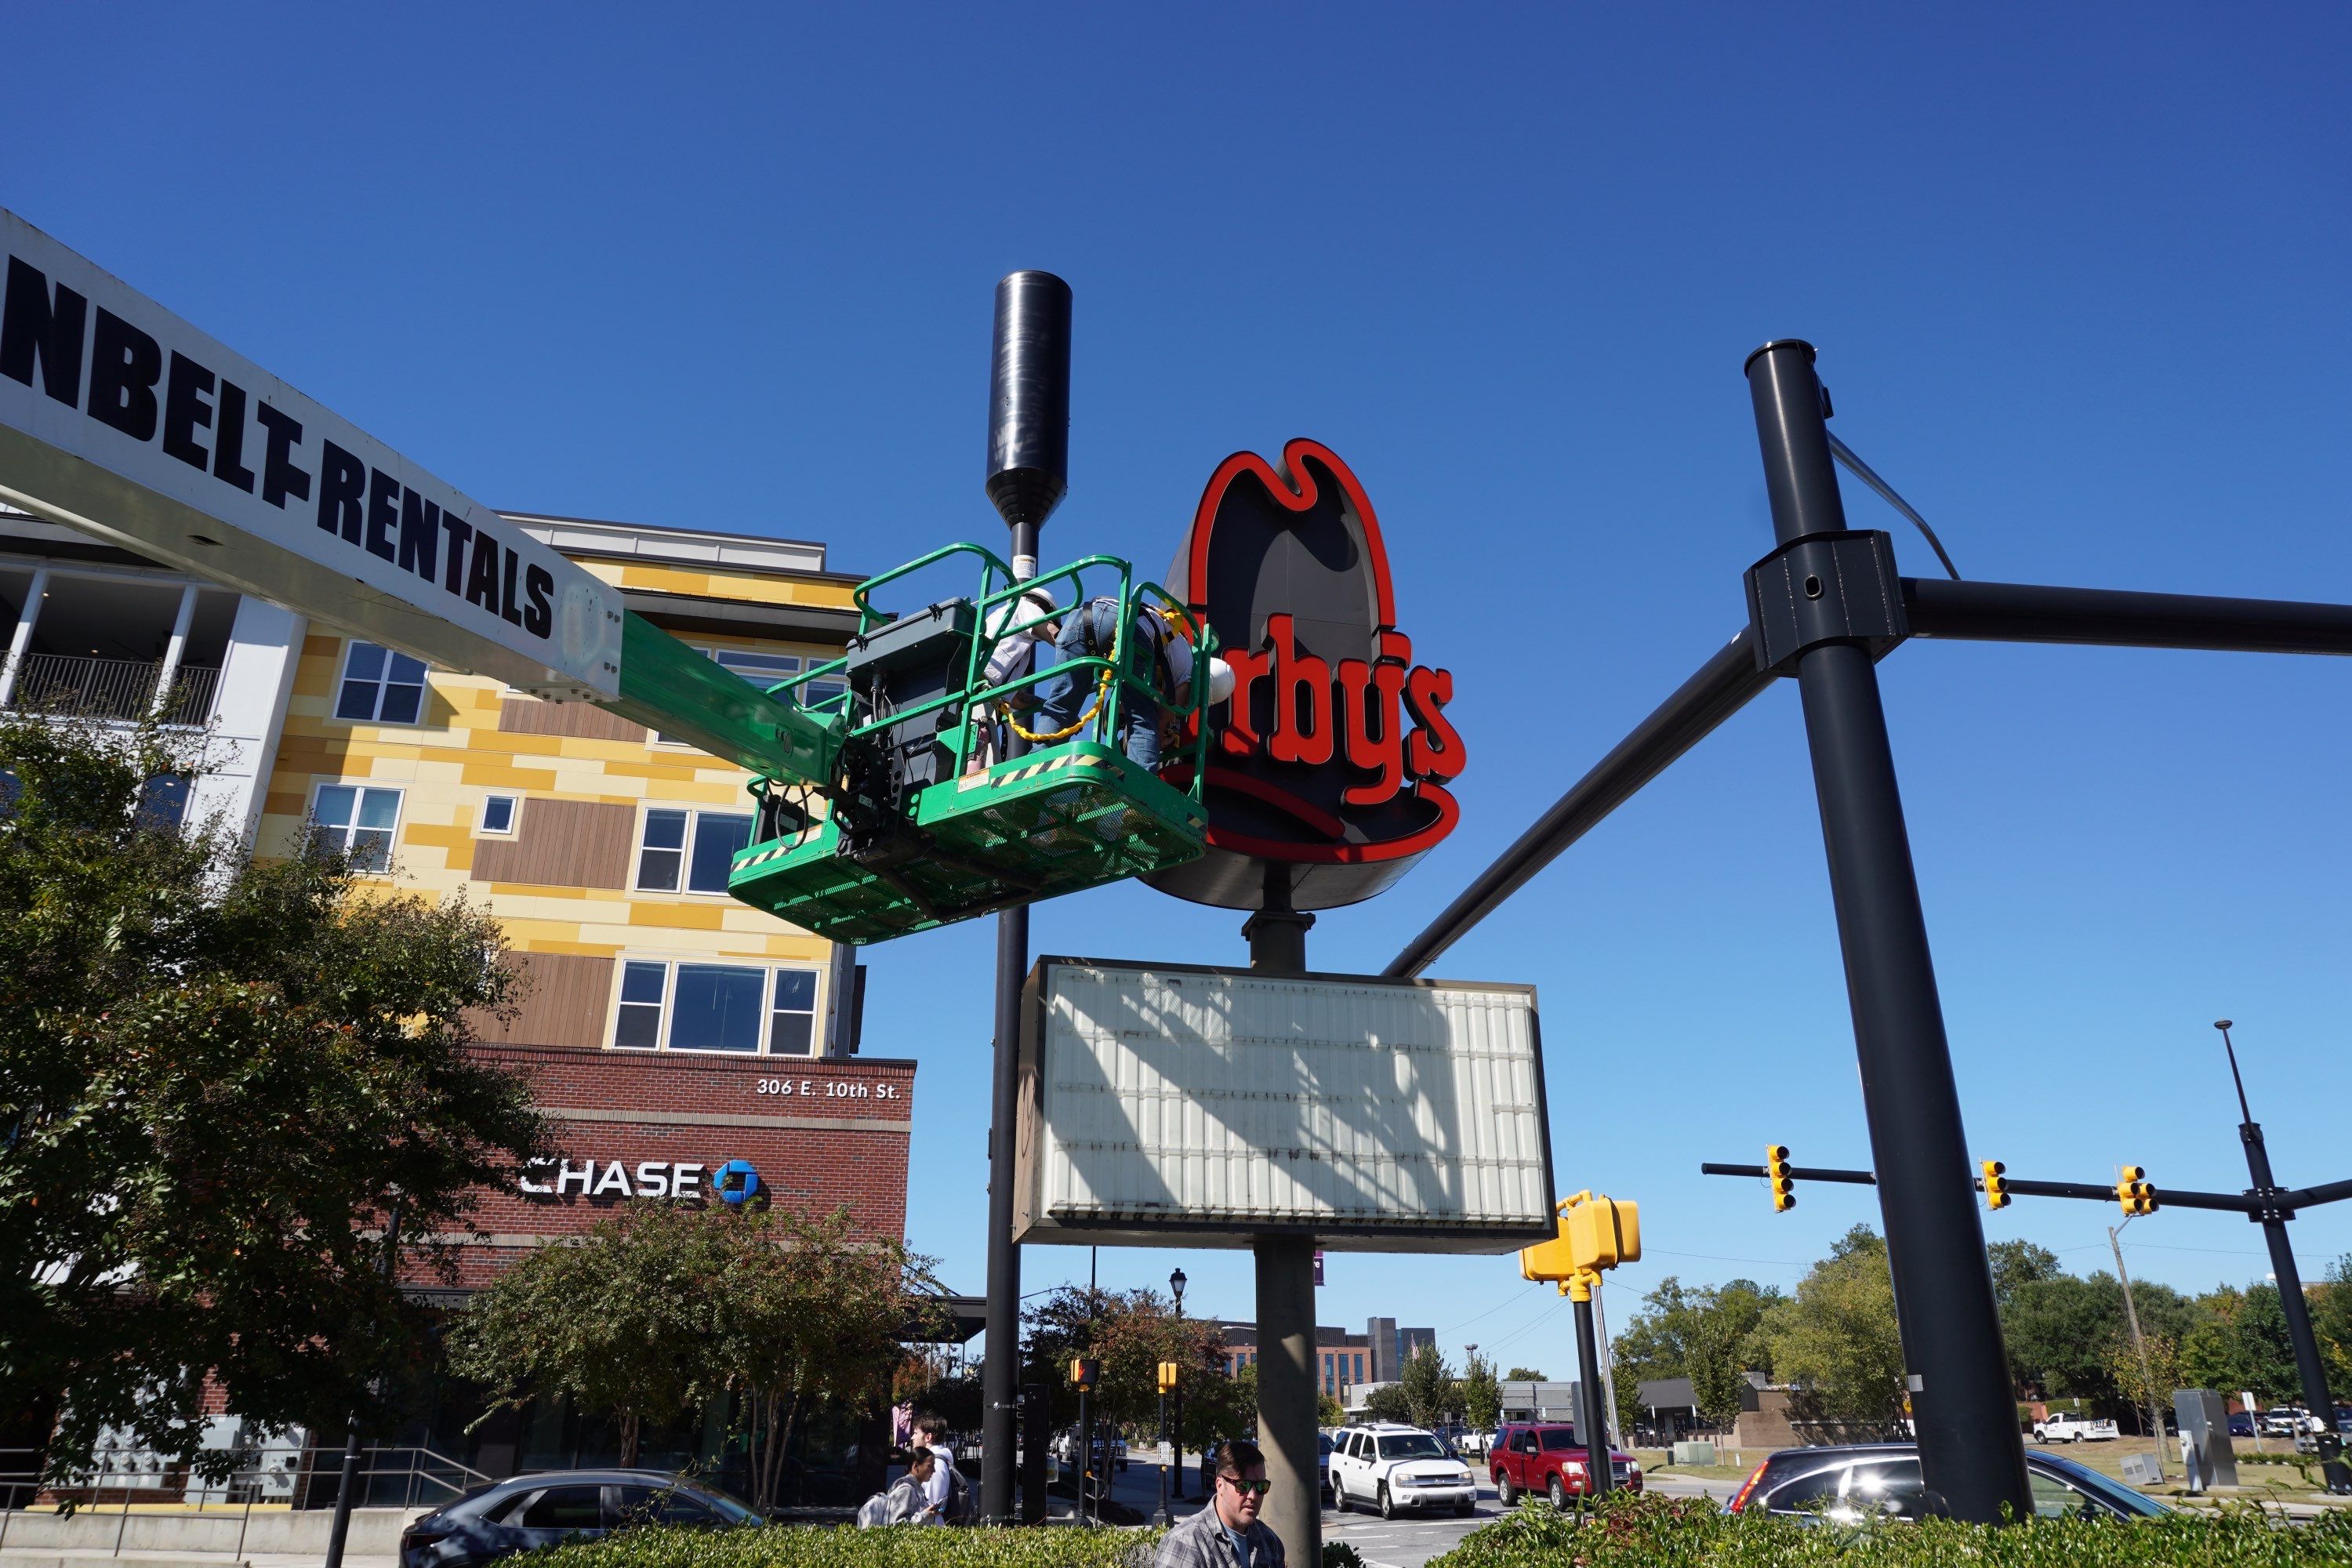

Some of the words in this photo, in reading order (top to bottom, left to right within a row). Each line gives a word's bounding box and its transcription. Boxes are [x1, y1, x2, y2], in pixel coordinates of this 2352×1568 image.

[317, 437, 554, 640] RENTALS
[757, 1079, 793, 1095] 306
[800, 1081, 816, 1096] E.
[826, 1082, 868, 1098] 10th
[876, 1083, 901, 1099] St.
[520, 1156, 705, 1199] CHASE
